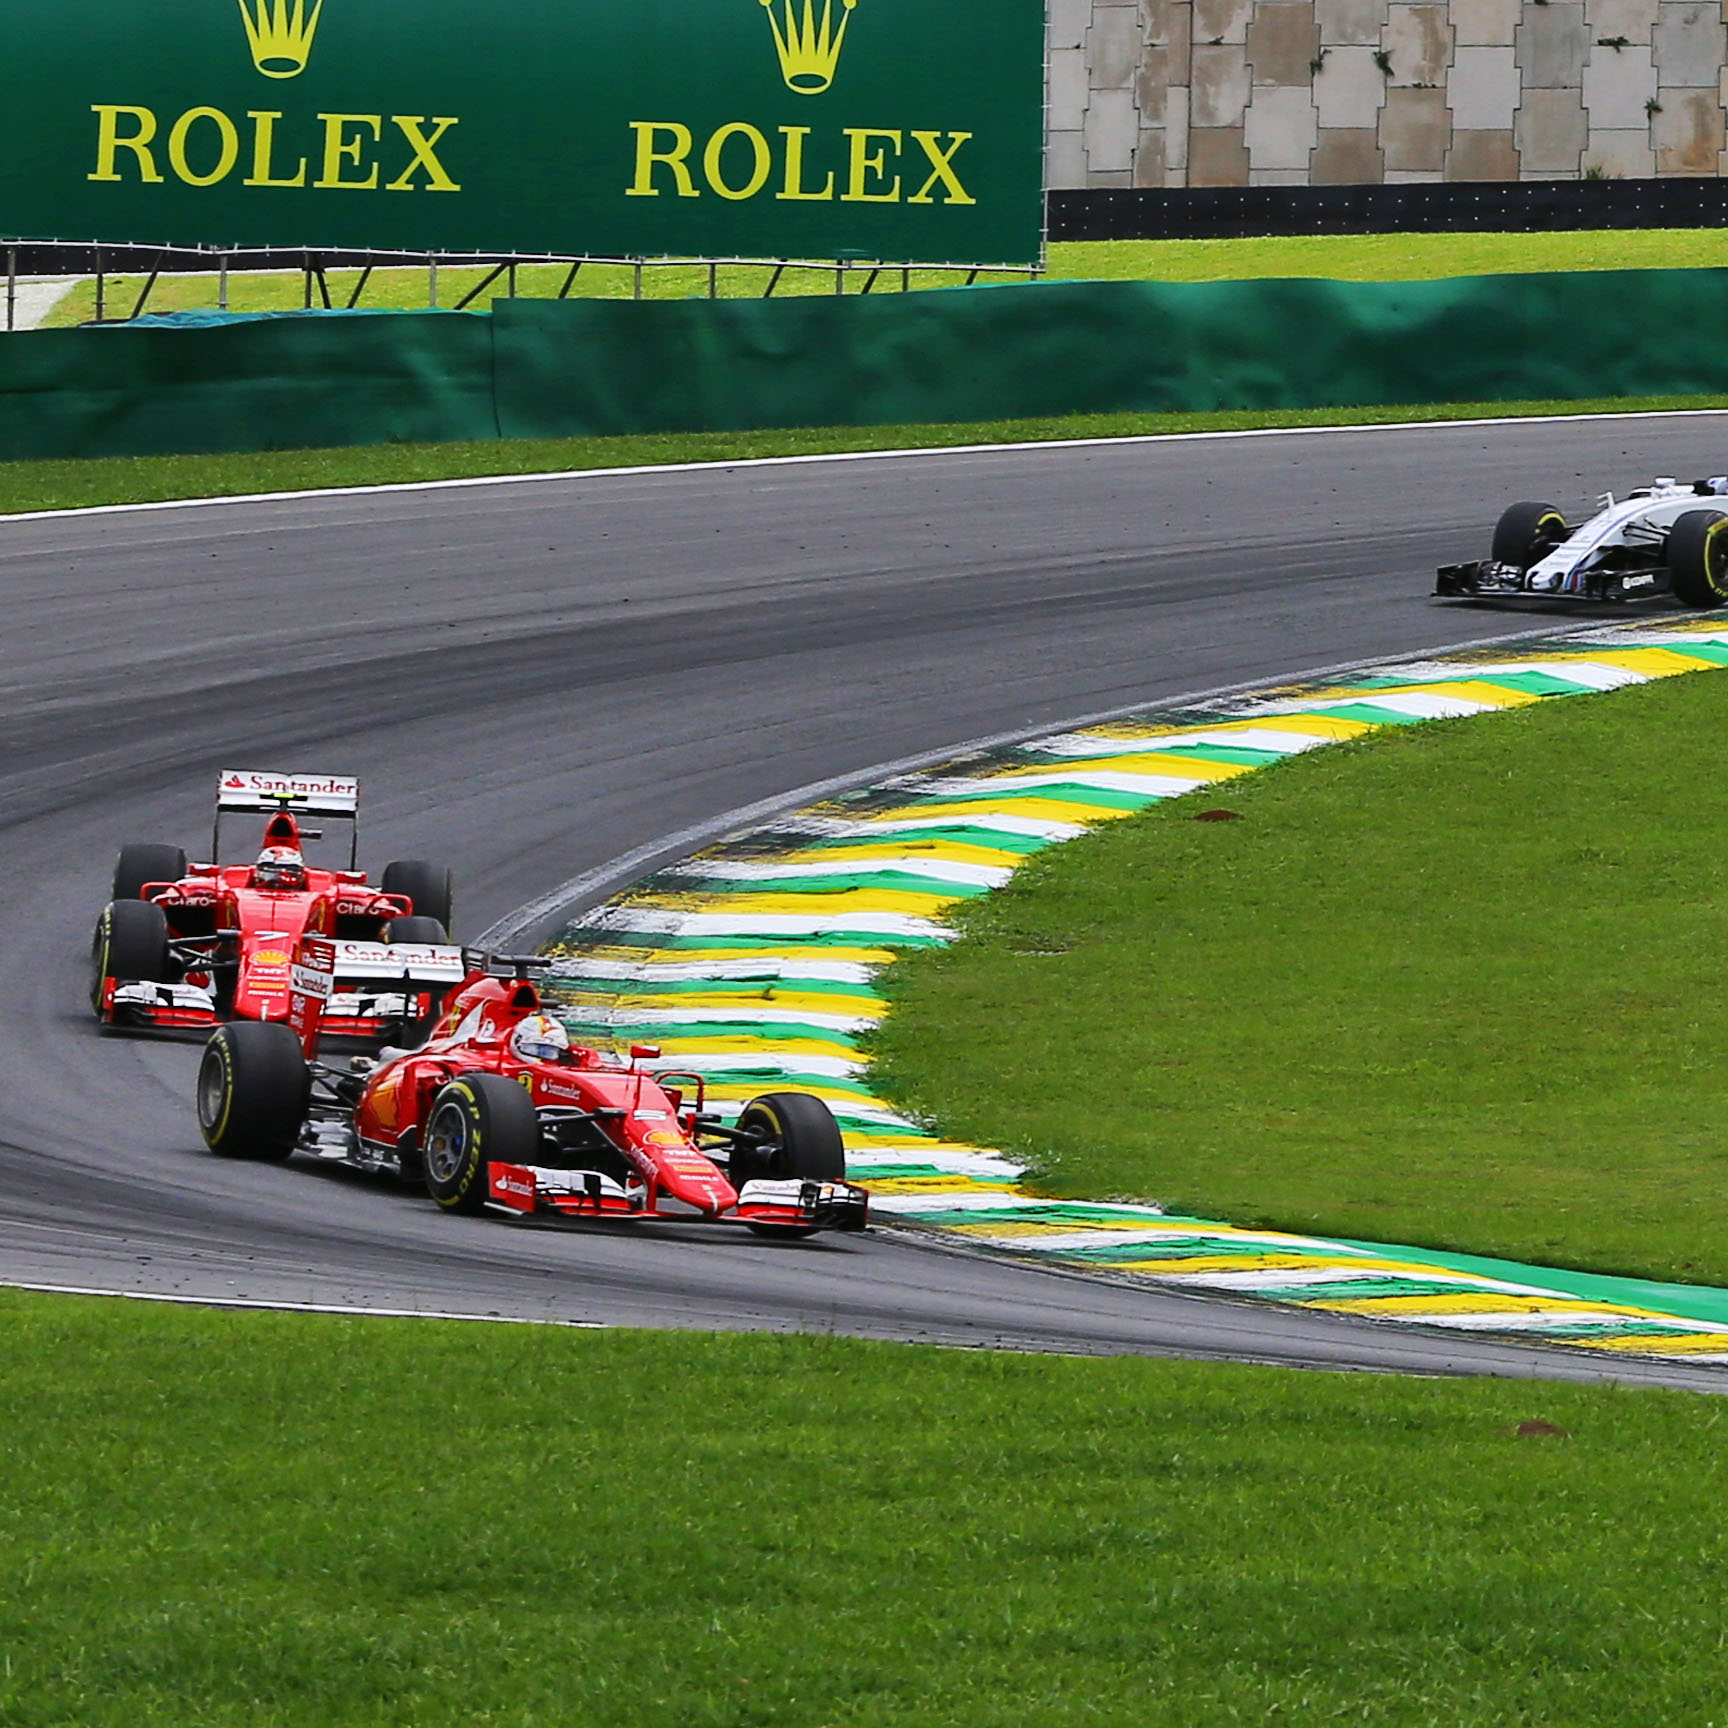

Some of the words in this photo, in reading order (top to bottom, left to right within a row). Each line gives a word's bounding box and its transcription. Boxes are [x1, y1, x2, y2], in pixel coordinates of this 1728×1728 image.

[88, 104, 461, 192] ROLEX
[625, 120, 977, 206] ROLEX
[250, 775, 355, 793] Santander
[344, 944, 460, 965] Santnder
